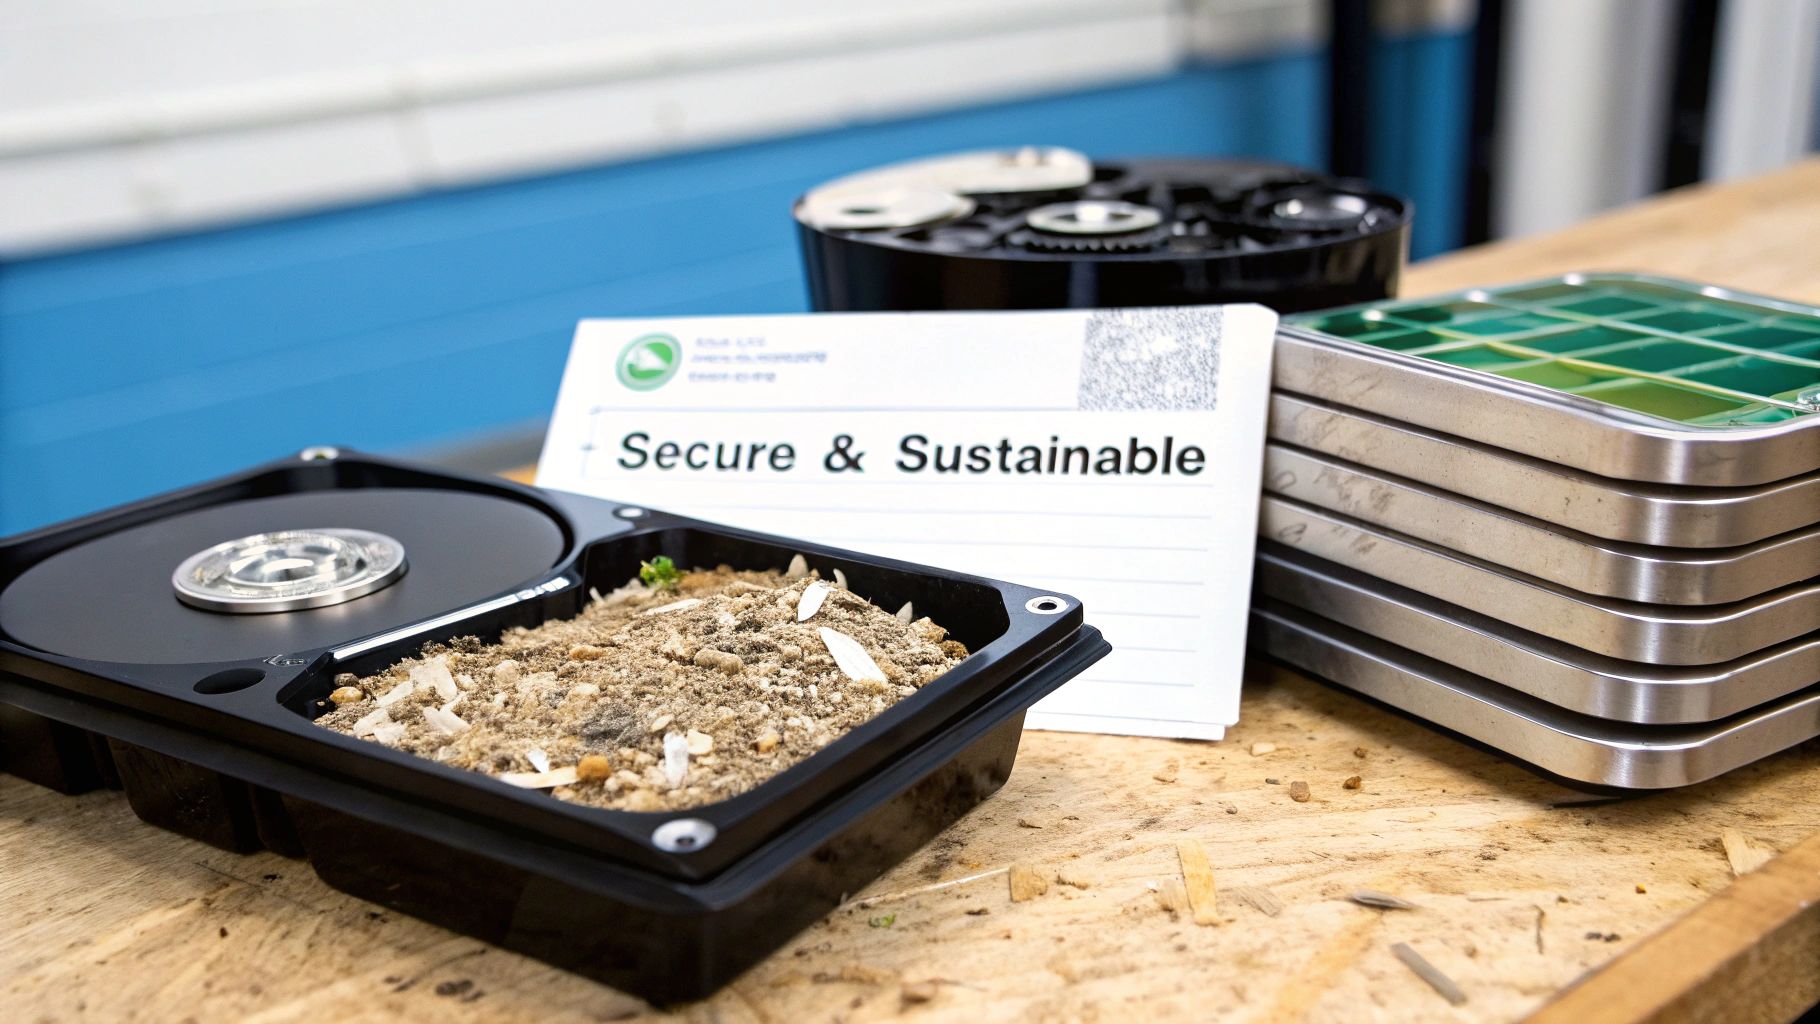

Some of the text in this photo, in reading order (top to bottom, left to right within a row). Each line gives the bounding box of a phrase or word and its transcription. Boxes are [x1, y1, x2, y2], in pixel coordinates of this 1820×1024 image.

[618, 432, 1206, 476] Secure & Sustainable
